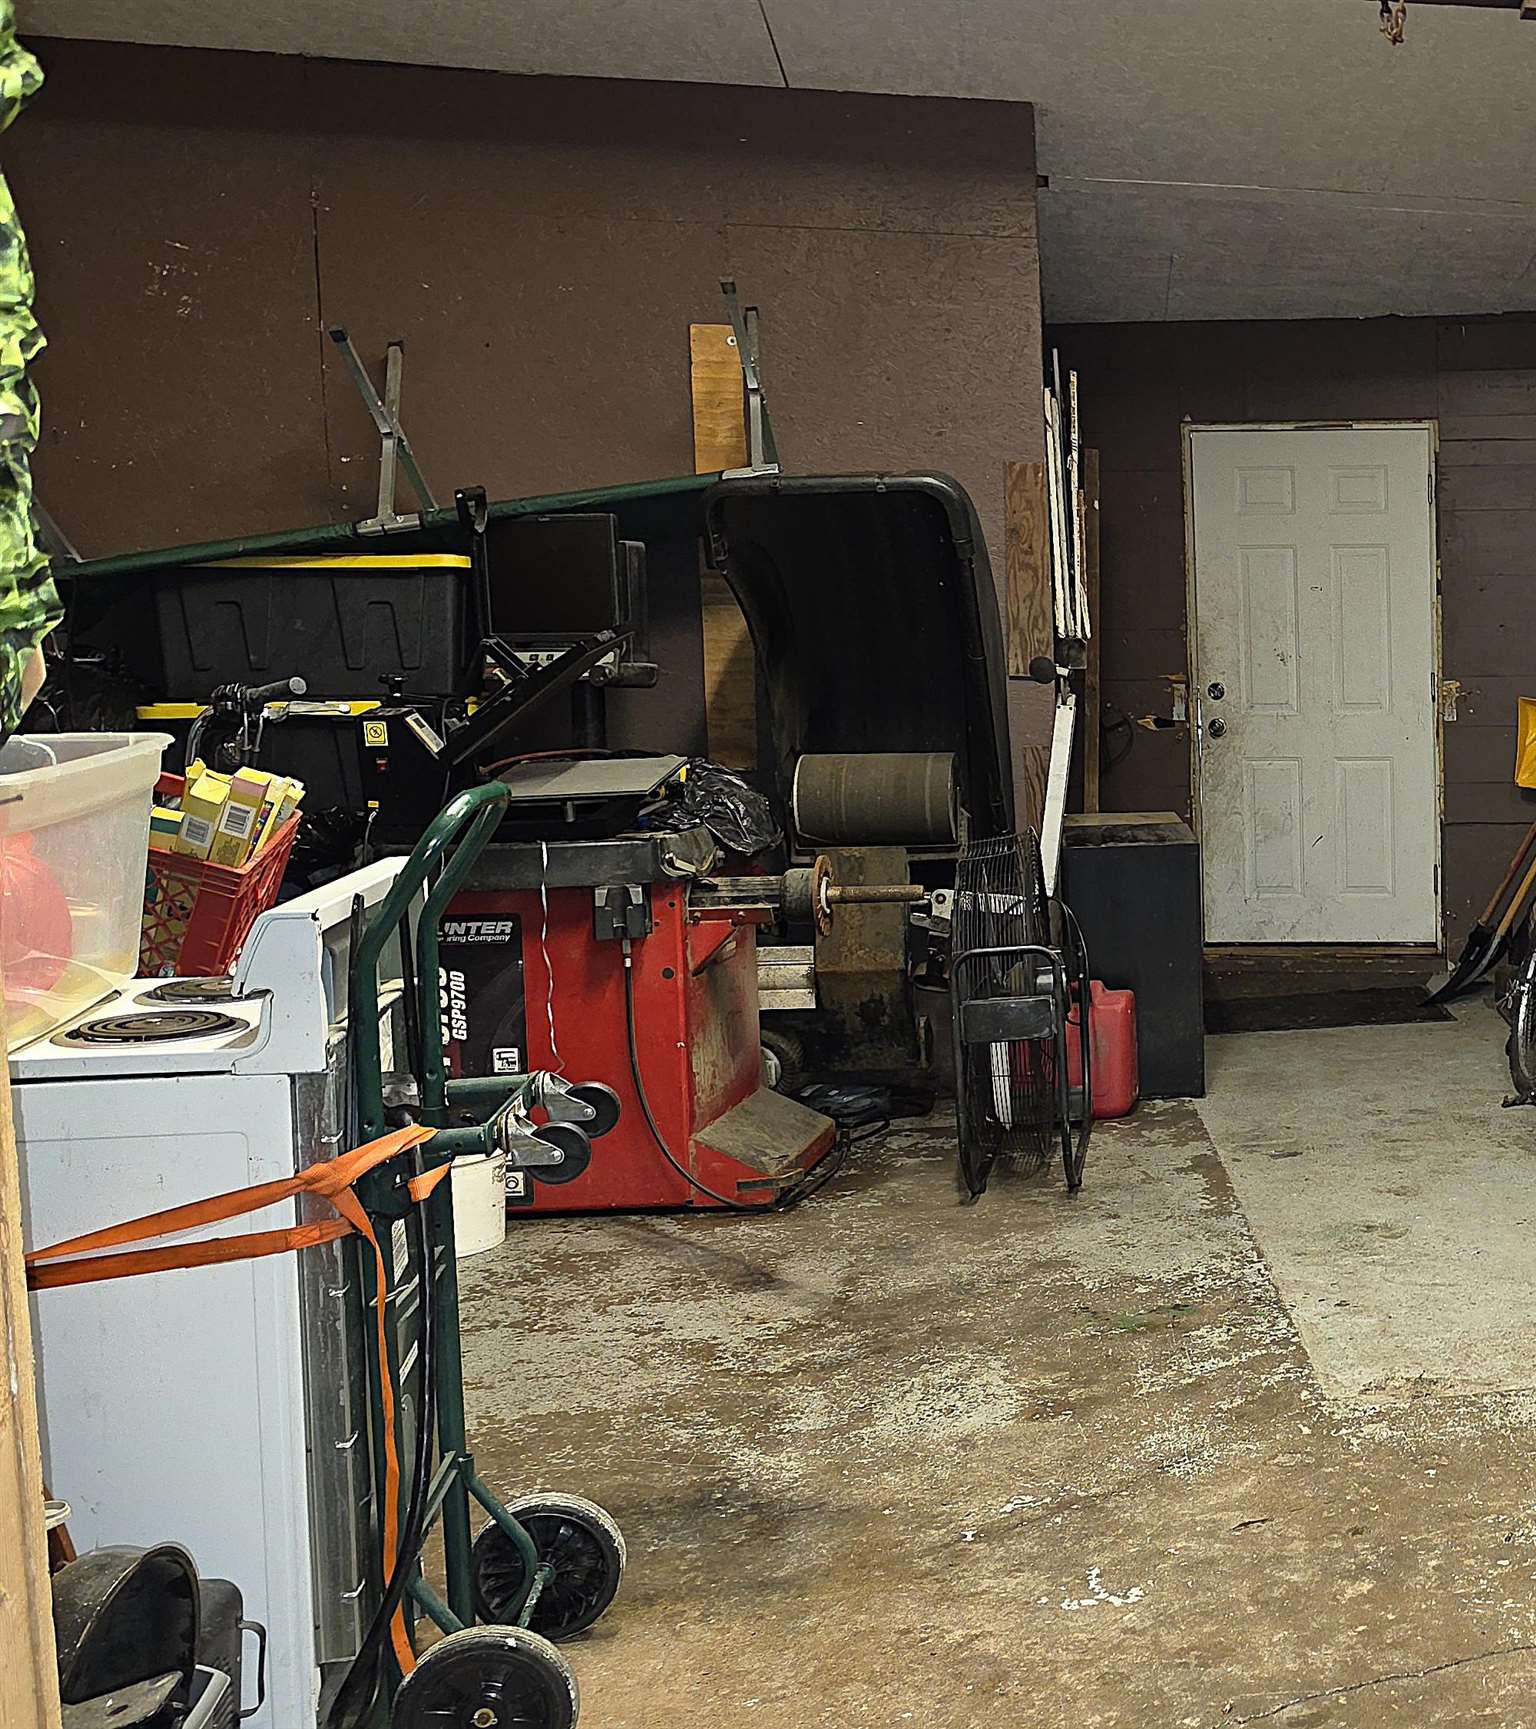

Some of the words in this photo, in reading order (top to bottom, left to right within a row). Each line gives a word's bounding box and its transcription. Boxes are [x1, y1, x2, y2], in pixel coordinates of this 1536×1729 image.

[441, 921, 513, 935] UNTER
[467, 934, 511, 943] Company
[450, 970, 468, 1041] GSP9700
